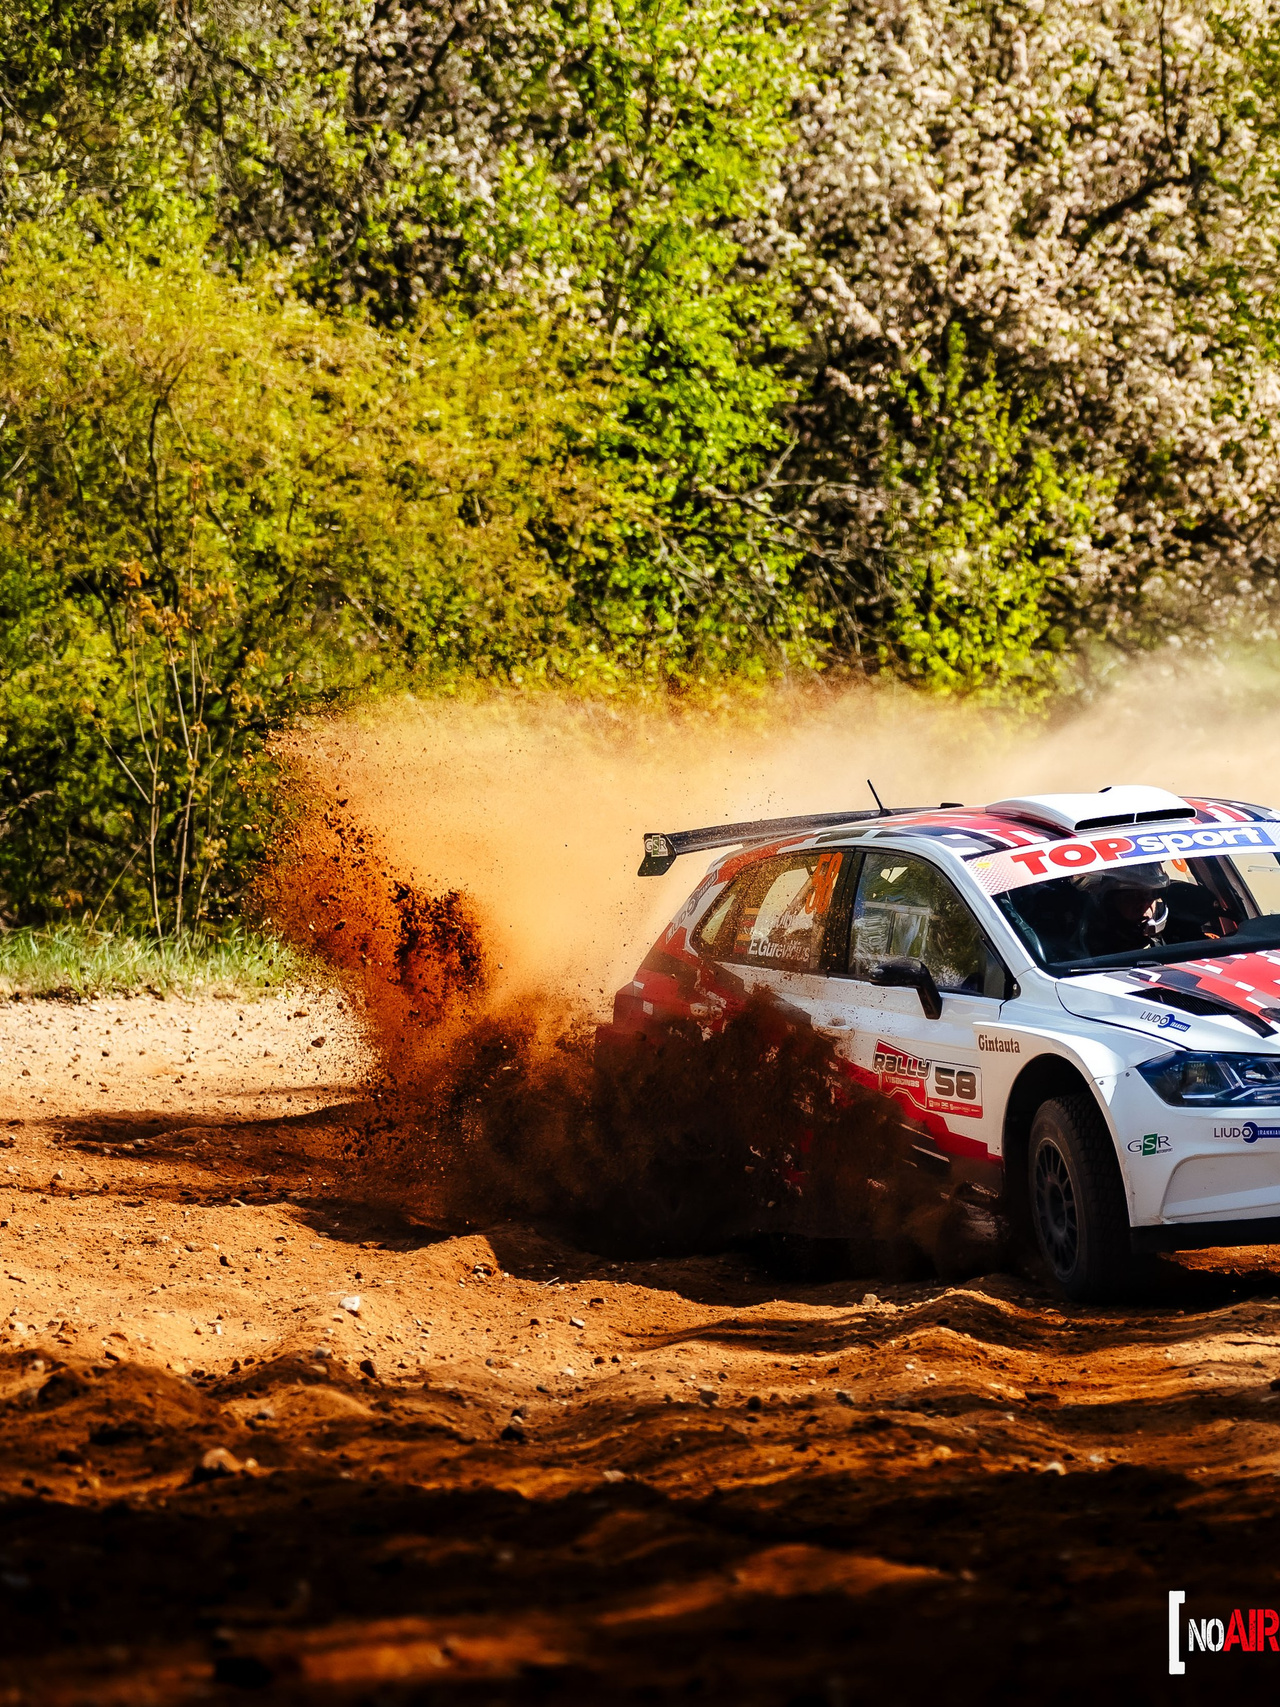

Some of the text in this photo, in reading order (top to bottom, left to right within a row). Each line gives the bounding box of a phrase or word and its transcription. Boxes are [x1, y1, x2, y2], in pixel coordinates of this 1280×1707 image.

[645, 837, 668, 853] GSR
[804, 851, 844, 915] 58
[1140, 1010, 1169, 1025] LIUDO
[978, 1033, 1021, 1054] Gintauta
[935, 1066, 977, 1101] 58
[1213, 1127, 1253, 1139] LIUDO
[1127, 1135, 1171, 1153] GSR
